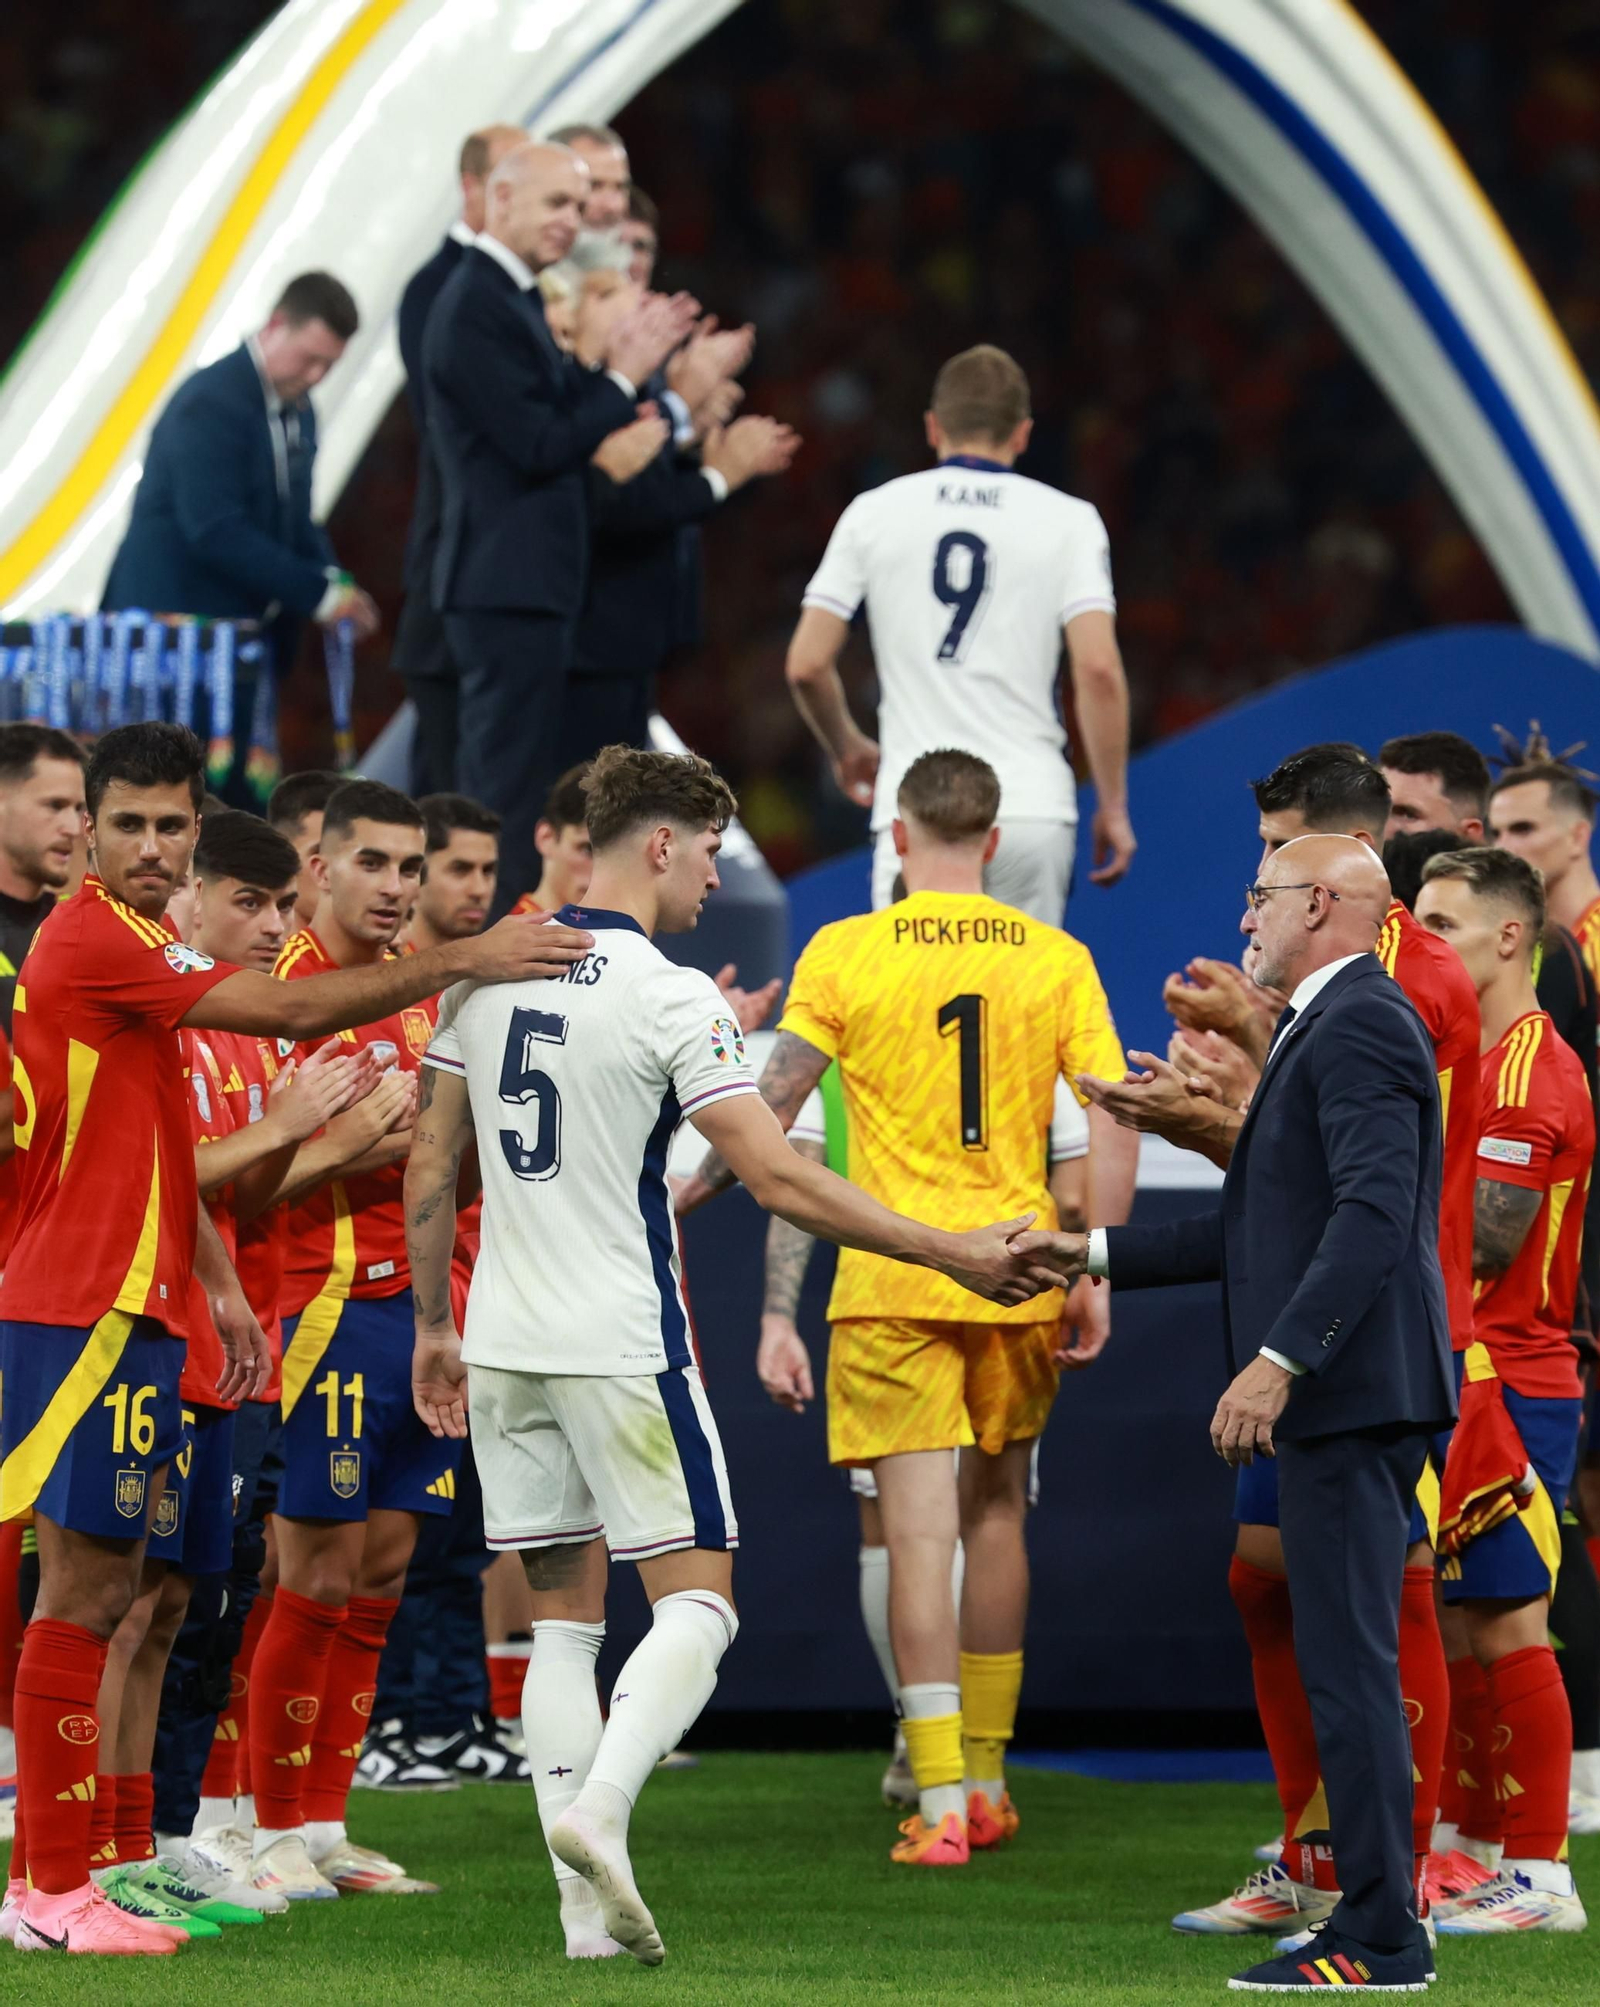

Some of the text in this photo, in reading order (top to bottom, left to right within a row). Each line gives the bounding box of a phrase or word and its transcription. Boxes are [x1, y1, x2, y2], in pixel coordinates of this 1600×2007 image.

[936, 484, 1004, 508] KANE
[933, 531, 994, 664] 9
[895, 917, 1026, 946] PICKFORD
[543, 952, 609, 986] NES
[498, 1005, 570, 1182] 5
[937, 993, 989, 1152] 1
[103, 1383, 158, 1456] 16
[315, 1370, 364, 1440] 11
